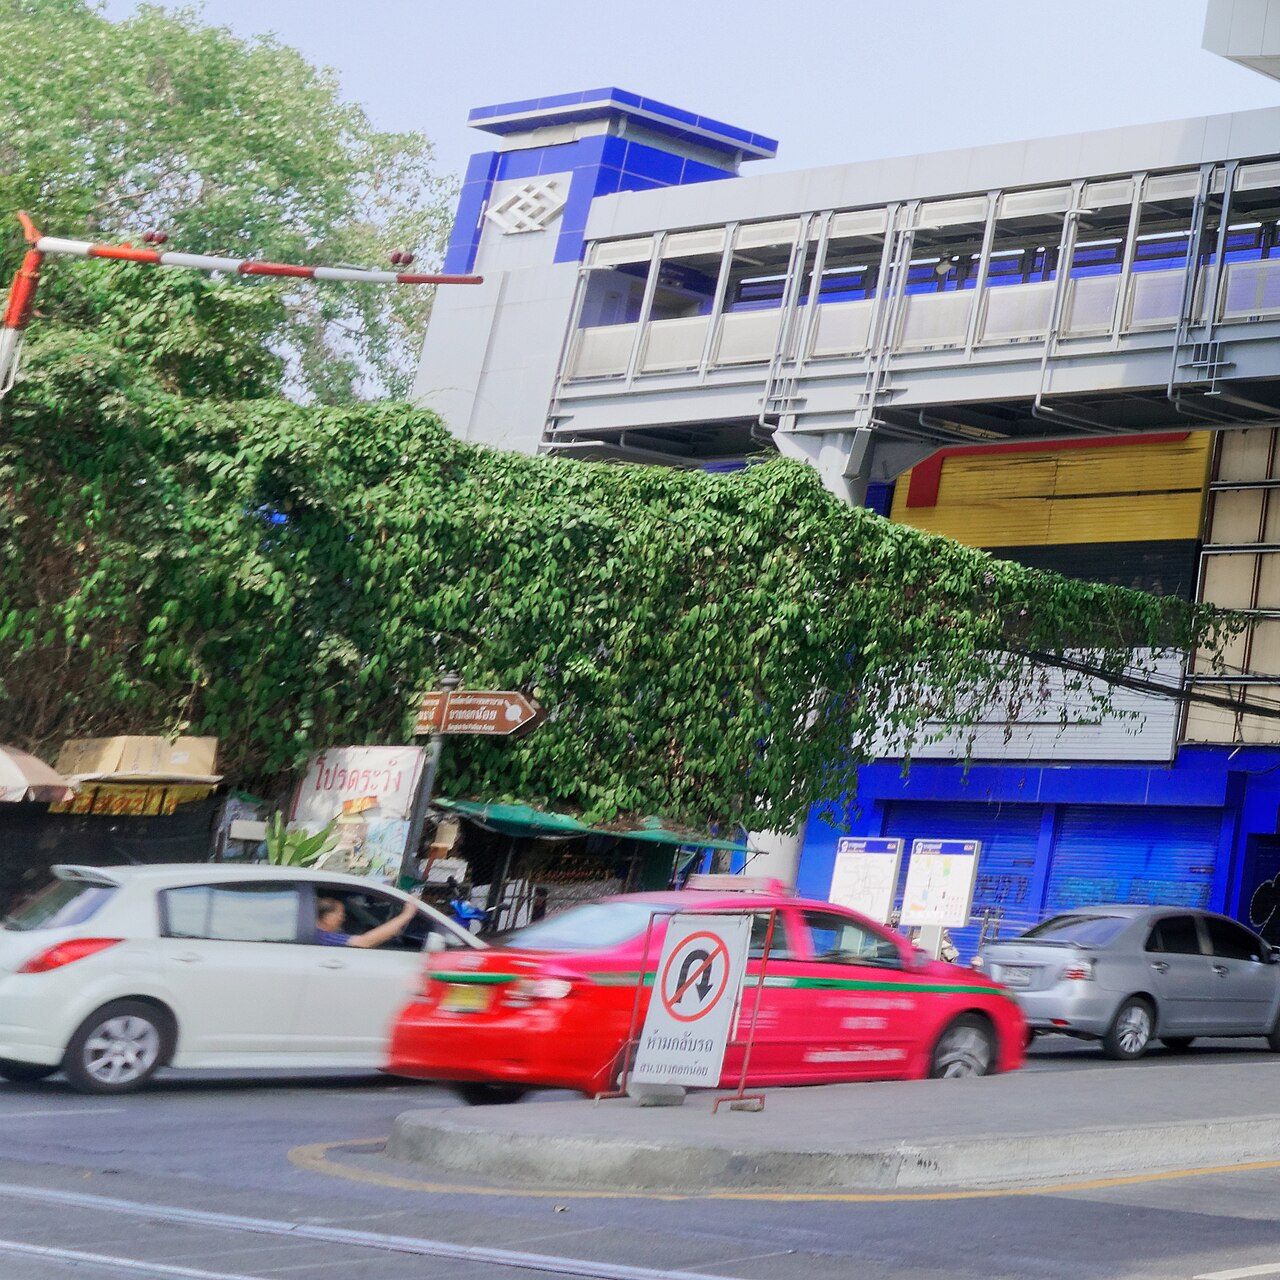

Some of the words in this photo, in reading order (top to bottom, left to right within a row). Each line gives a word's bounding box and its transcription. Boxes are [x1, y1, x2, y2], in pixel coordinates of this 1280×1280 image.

[315, 756, 402, 792] โปรดระวัง
[646, 1029, 714, 1053] ห้ามกลับรถ
